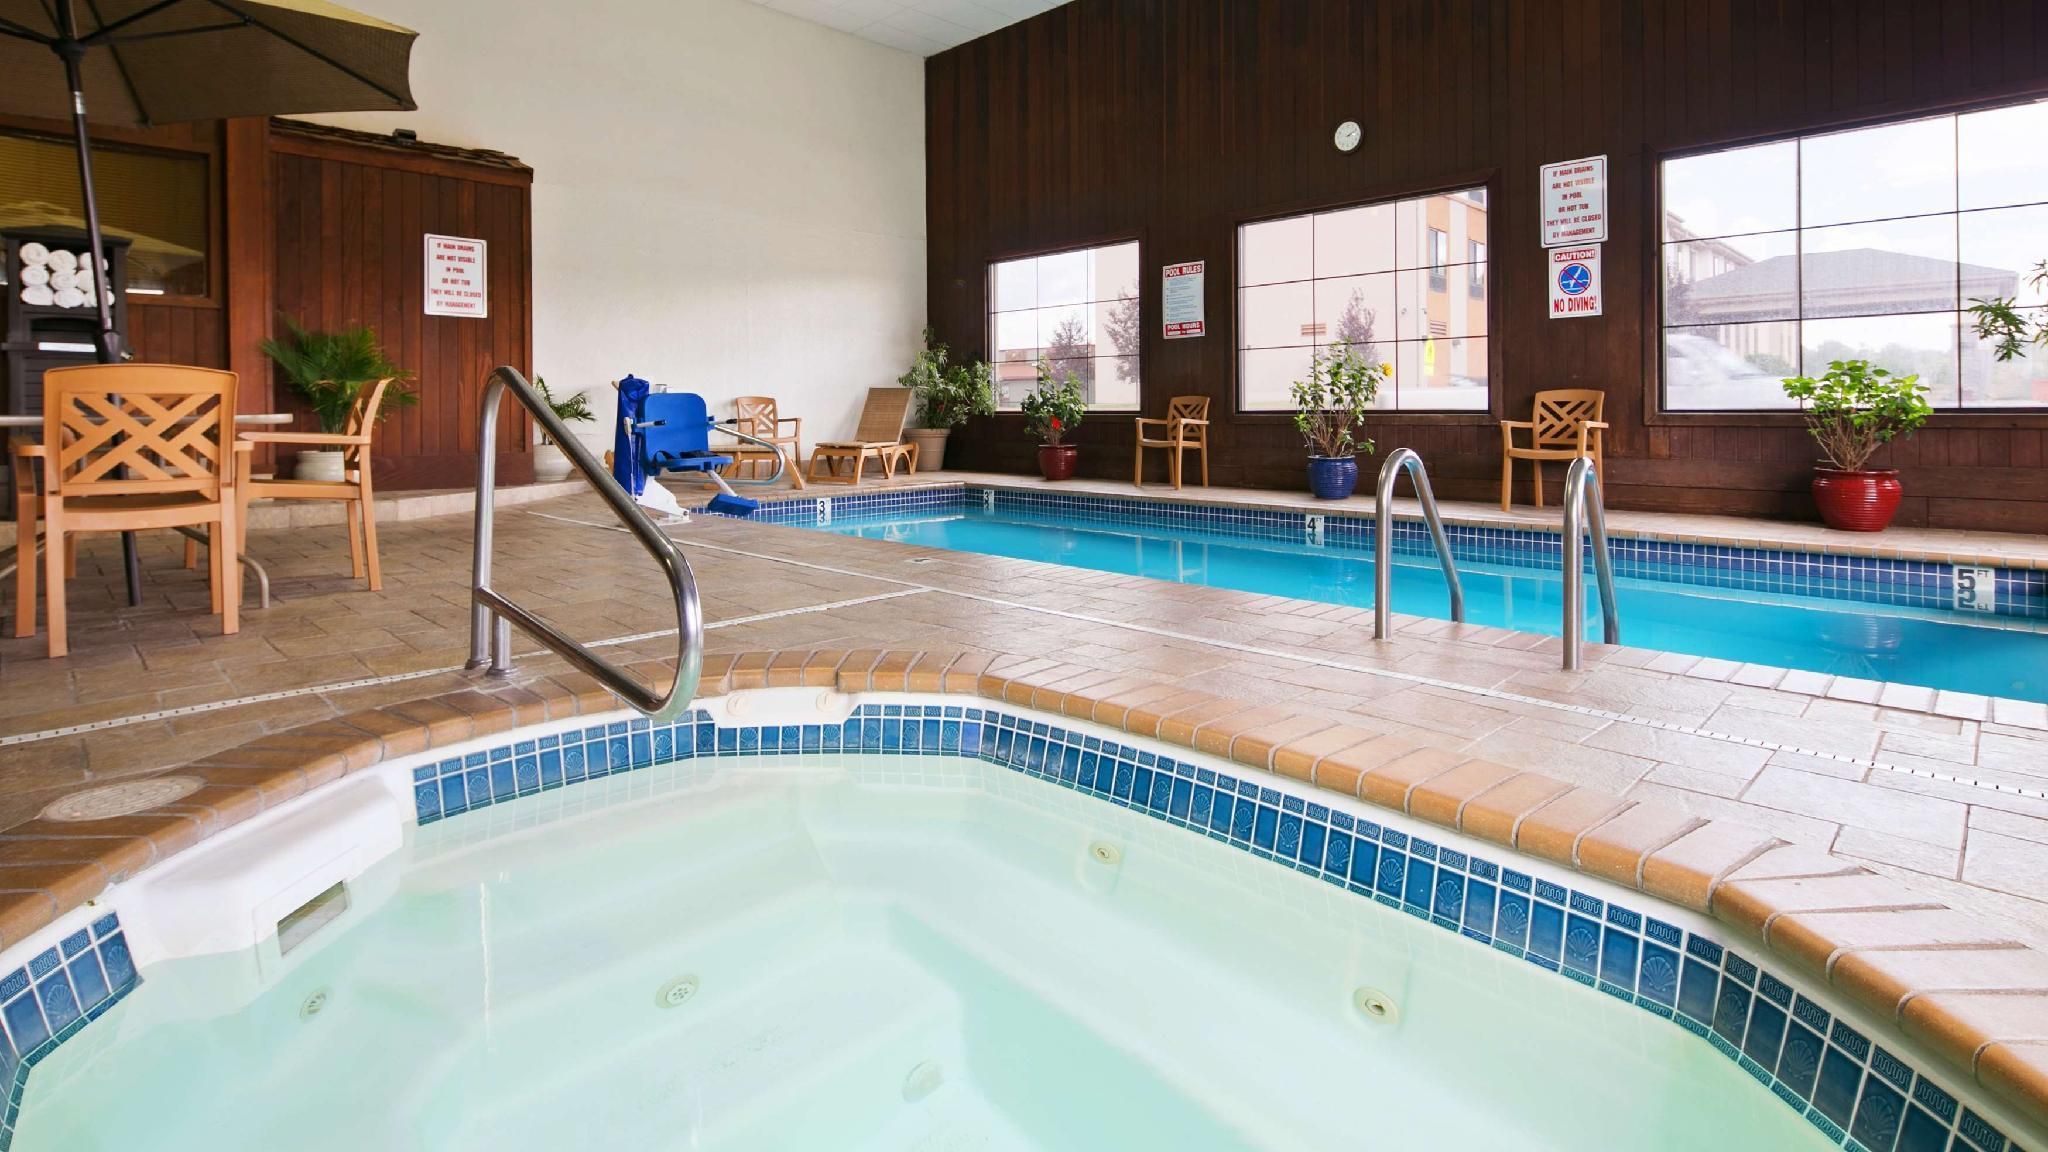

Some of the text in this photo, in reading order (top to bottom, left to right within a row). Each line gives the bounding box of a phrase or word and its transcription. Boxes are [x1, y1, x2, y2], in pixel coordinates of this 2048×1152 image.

[1574, 166, 1593, 174] DRAINS
[1561, 227, 1595, 236] MANAGEMENT
[1556, 250, 1594, 261] CAUTION!
[1166, 265, 1201, 277] POOL RULES
[1554, 296, 1596, 312] NO DIVING!
[819, 500, 825, 512] 3
[1308, 517, 1316, 531] 4
[1958, 569, 1975, 589] 5
